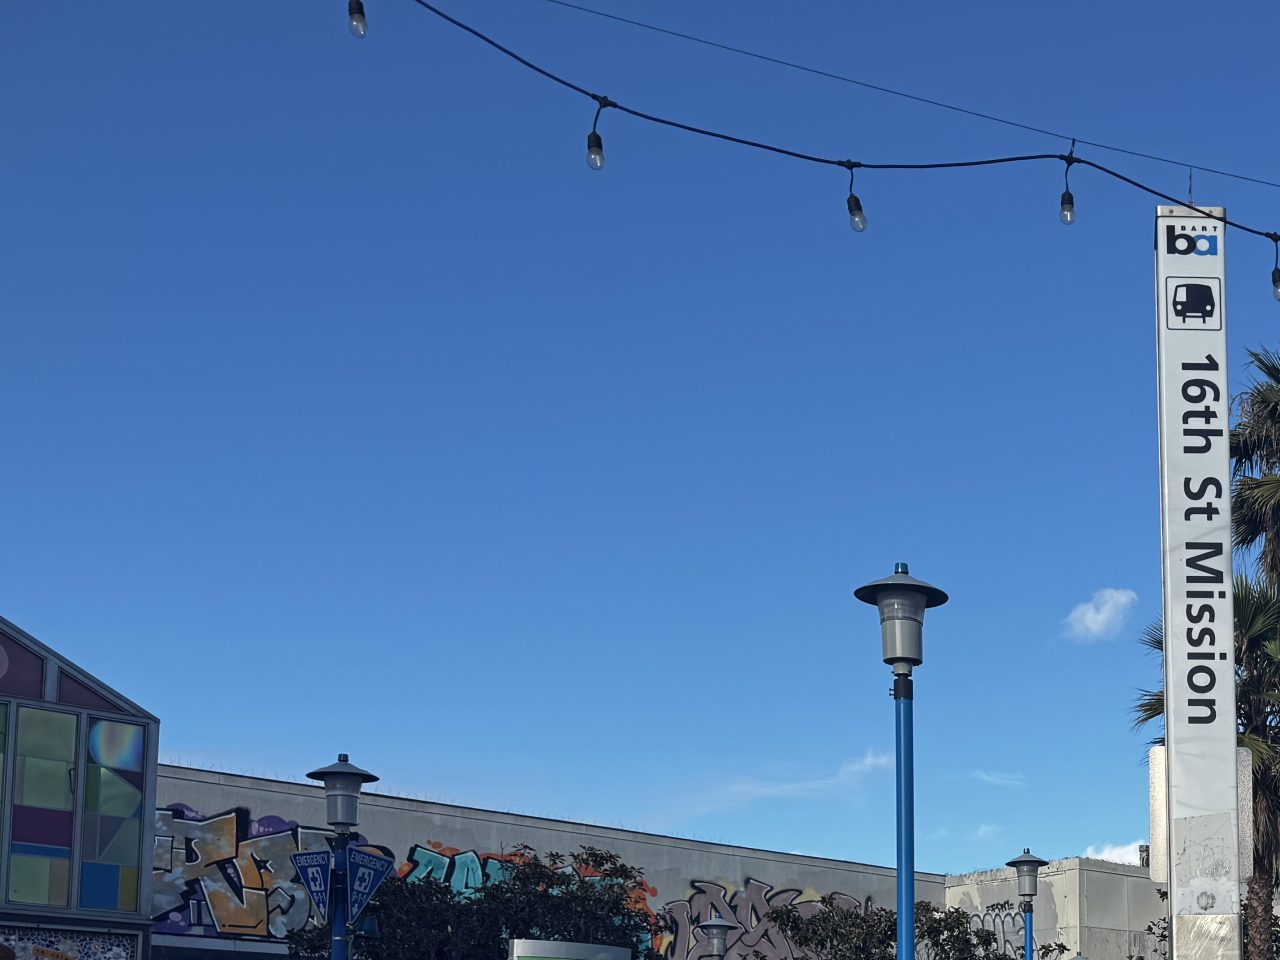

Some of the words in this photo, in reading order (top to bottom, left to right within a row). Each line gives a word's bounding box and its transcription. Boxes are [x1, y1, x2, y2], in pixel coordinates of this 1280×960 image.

[1180, 354, 1225, 455] 16th
[1184, 477, 1224, 522] St
[1184, 542, 1228, 725] Mission
[296, 853, 328, 867] EMERGENCY
[350, 851, 388, 872] EMERGENCY
[313, 891, 327, 903] 9-1-1
[351, 892, 367, 903] 9-1-1
